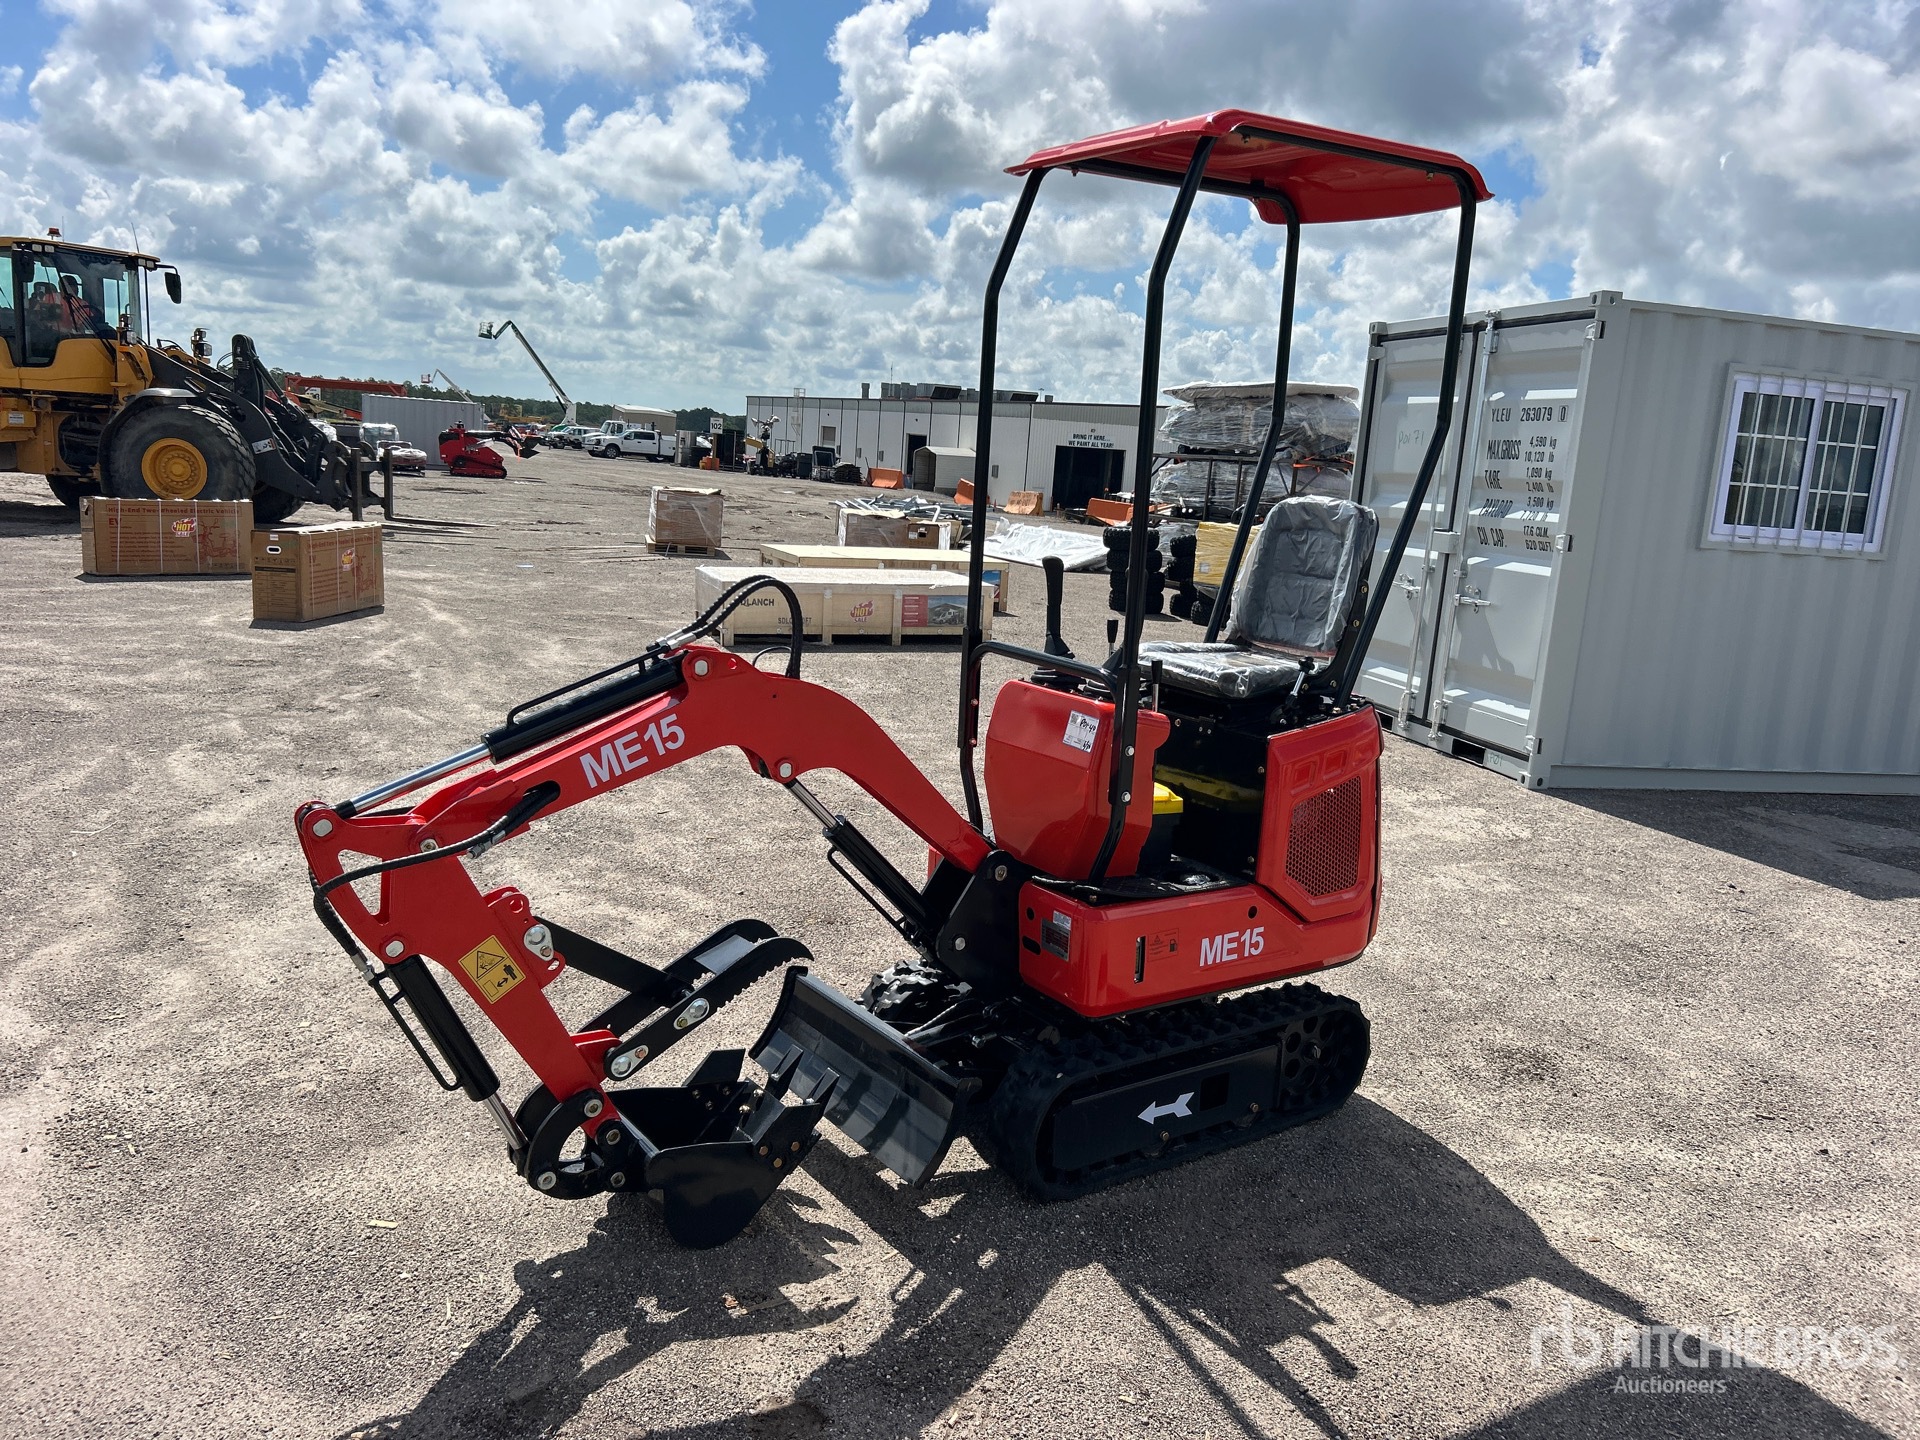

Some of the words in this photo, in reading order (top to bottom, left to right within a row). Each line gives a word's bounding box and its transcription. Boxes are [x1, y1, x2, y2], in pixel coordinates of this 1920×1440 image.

[1491, 407, 1511, 422] YLEU
[1520, 406, 1552, 422] 263079
[1530, 436, 1547, 448] 4,590
[1550, 436, 1557, 450] kg
[1524, 451, 1544, 463] 10,120
[1548, 451, 1554, 462] lb
[1485, 470, 1502, 489] TARE
[1526, 467, 1542, 479] 1,090
[1545, 468, 1552, 481] kg
[1526, 482, 1544, 493] 2,400
[1527, 497, 1544, 508] 3,500
[1546, 497, 1554, 510] kg
[854, 607, 869, 617] HOT
[580, 714, 685, 788] ME15
[1200, 926, 1264, 966] ME15
